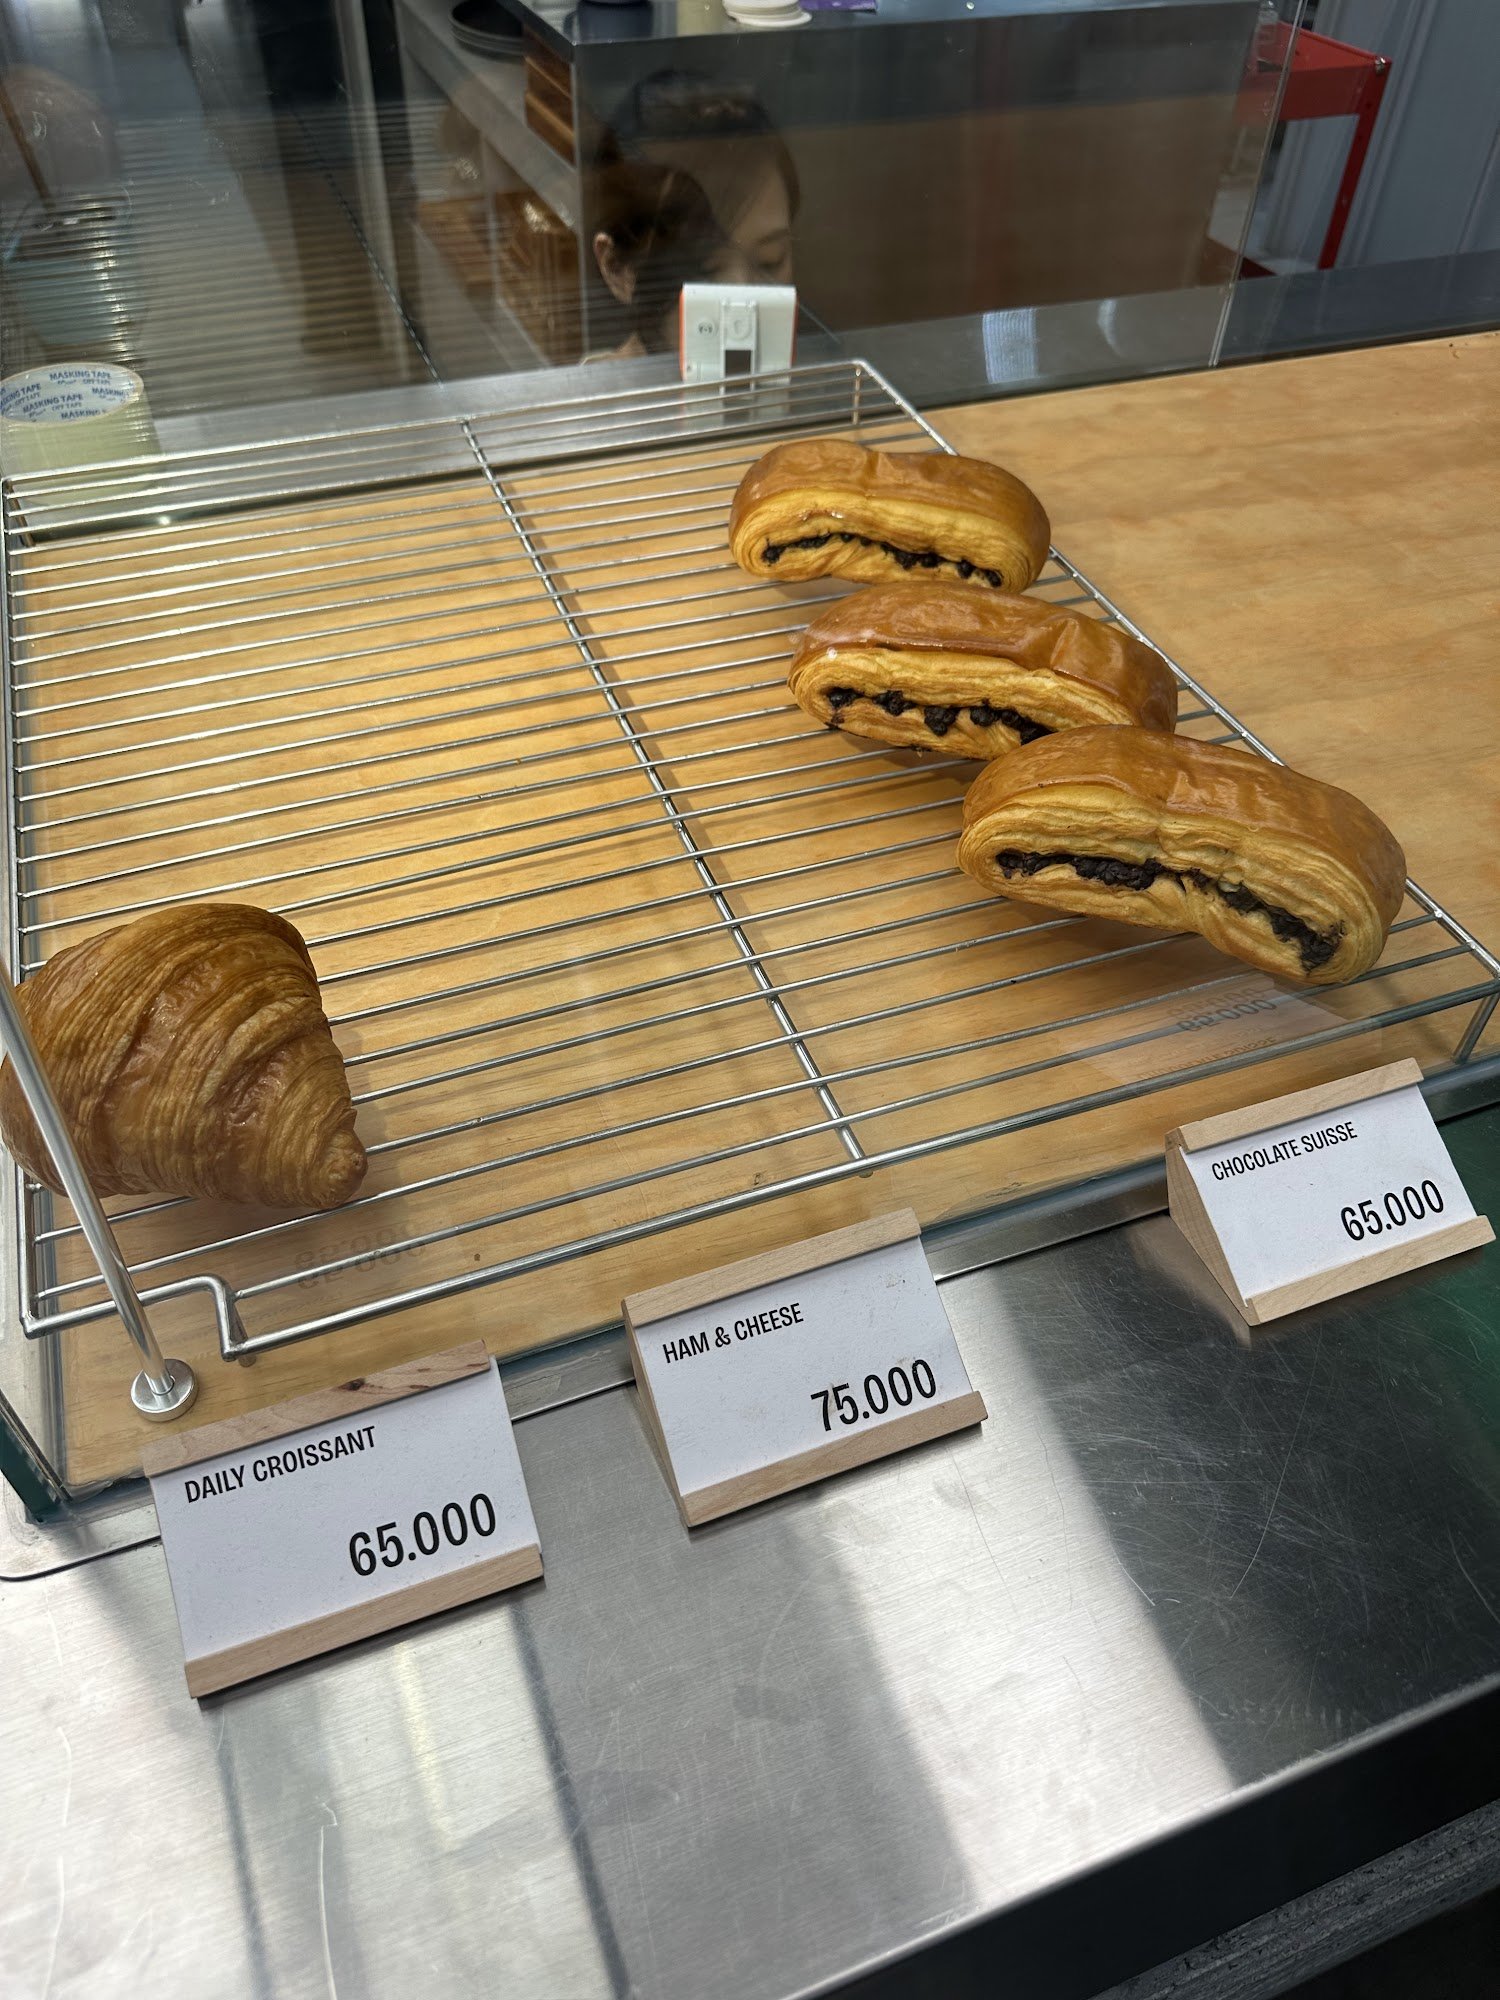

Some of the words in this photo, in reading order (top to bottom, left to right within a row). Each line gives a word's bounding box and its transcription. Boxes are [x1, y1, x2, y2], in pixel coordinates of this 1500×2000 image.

[20, 383, 41, 395] TAPE
[23, 397, 60, 413] MASKING
[60, 394, 83, 403] TAPE
[49, 370, 90, 380] MASKING
[91, 370, 112, 380] TAPE
[1212, 1139, 1301, 1181] CHOCOLATE
[1300, 1121, 1358, 1153] SUISSE
[1340, 1179, 1444, 1241] 65.000
[662, 1331, 710, 1364] HAM
[714, 1326, 732, 1348] &
[734, 1302, 805, 1341] CHEESE
[810, 1359, 937, 1431] 75.000
[184, 1464, 246, 1503] DAILY
[252, 1425, 377, 1482] CROISSANT
[348, 1493, 496, 1576] 65.000
